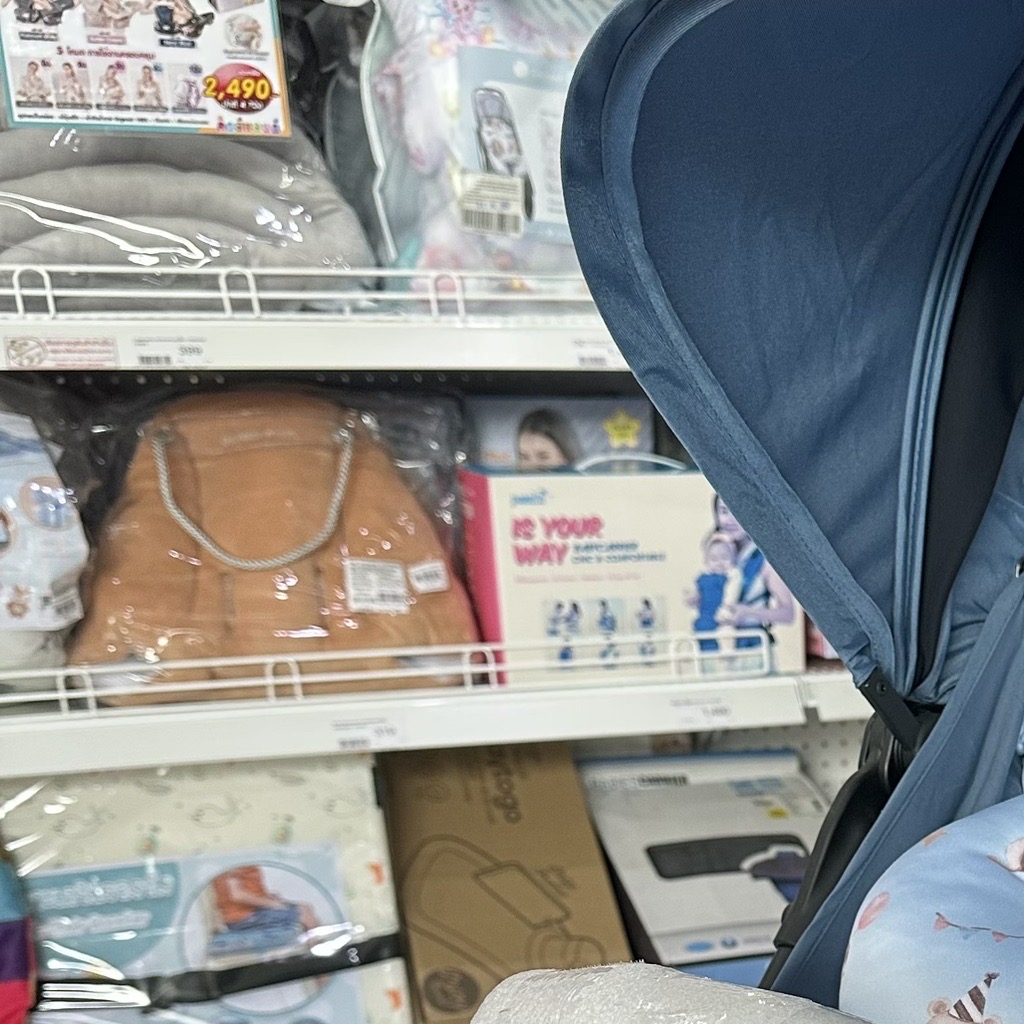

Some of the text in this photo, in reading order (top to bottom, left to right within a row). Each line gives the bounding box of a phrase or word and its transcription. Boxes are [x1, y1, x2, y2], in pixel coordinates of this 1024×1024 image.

[512, 513, 606, 539] IS YOUR
[512, 543, 569, 566] WAY
